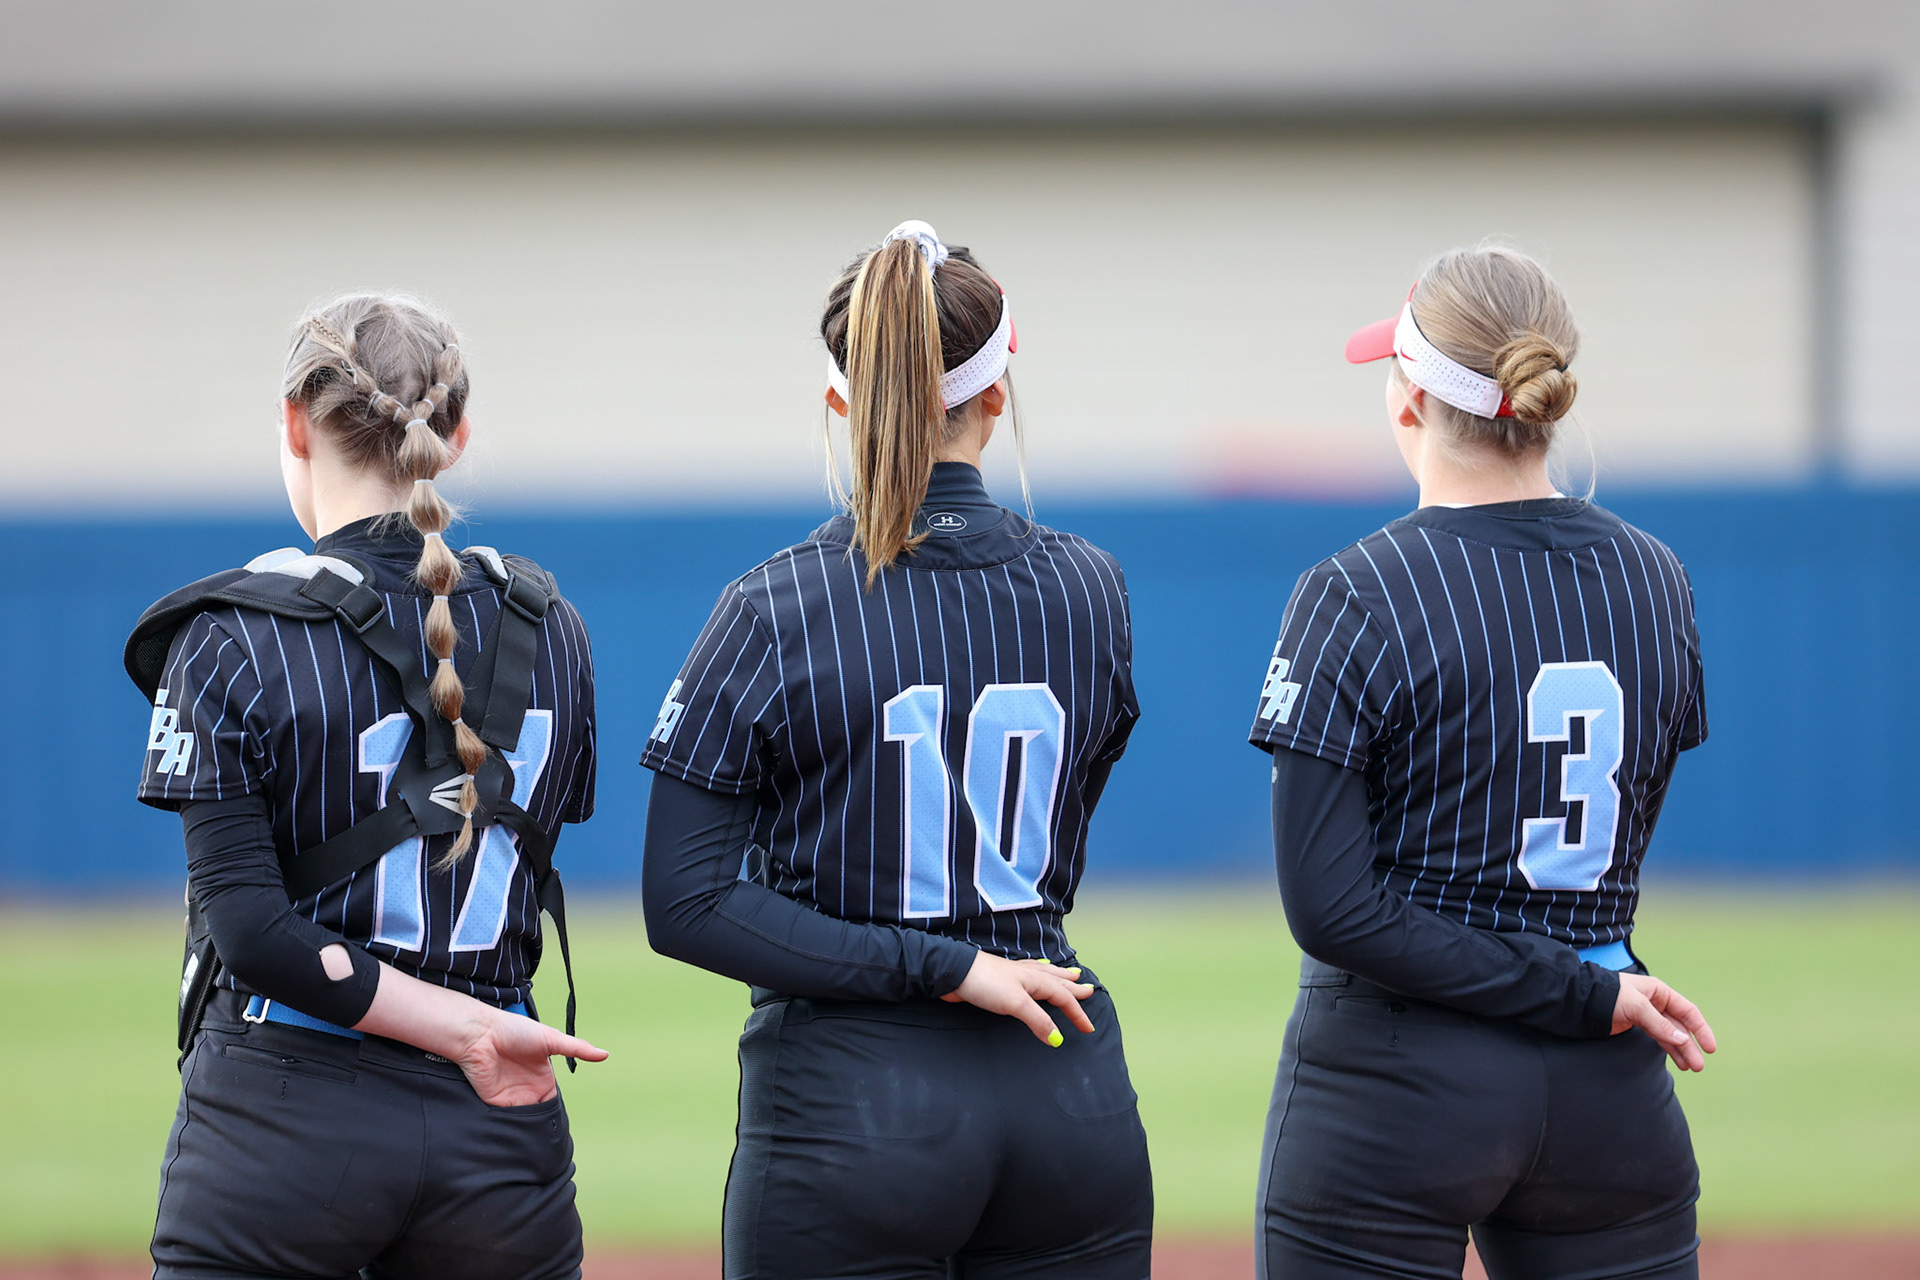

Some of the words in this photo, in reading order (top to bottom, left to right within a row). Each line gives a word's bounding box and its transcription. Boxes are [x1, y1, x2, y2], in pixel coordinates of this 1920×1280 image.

[1260, 640, 1302, 725] BA
[1517, 661, 1624, 891] 3
[358, 709, 553, 952] 17
[883, 683, 1066, 918] 10
